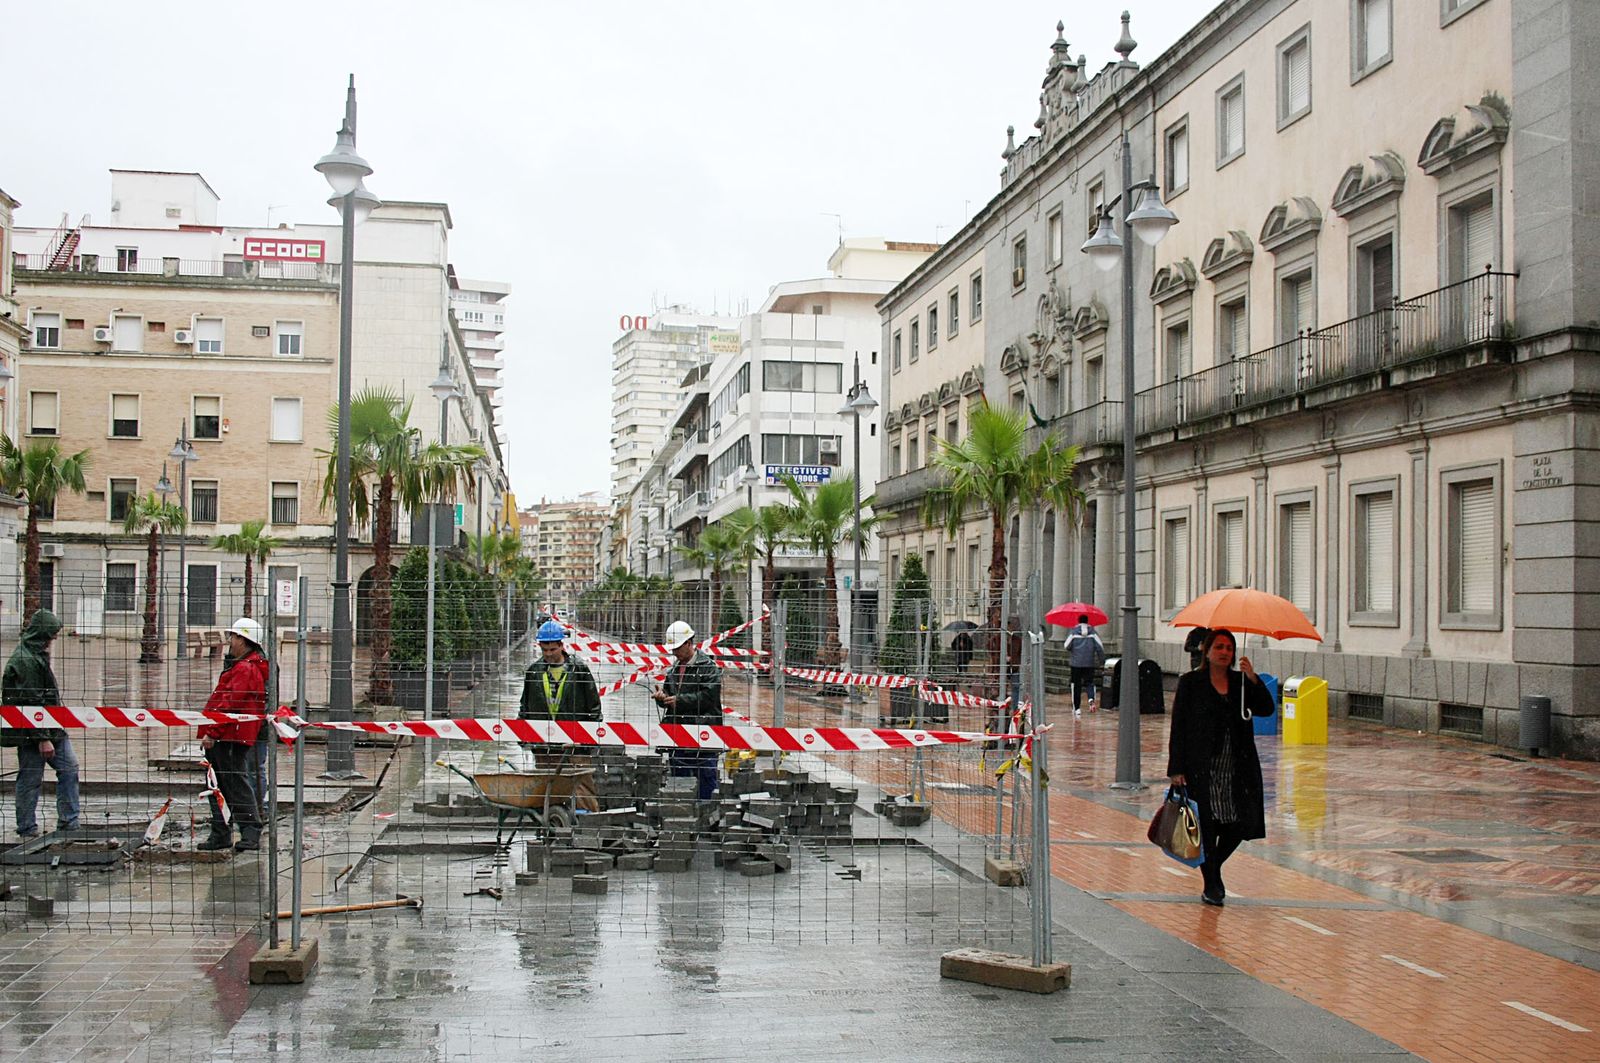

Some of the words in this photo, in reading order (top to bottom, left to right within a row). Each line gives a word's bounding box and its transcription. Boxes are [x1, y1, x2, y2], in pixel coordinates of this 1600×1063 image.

[246, 242, 306, 258] CCOO
[1533, 456, 1552, 466] PLAZA
[767, 466, 829, 475] DETECTIVES
[1533, 468, 1541, 477] DE
[1544, 468, 1552, 476] LA
